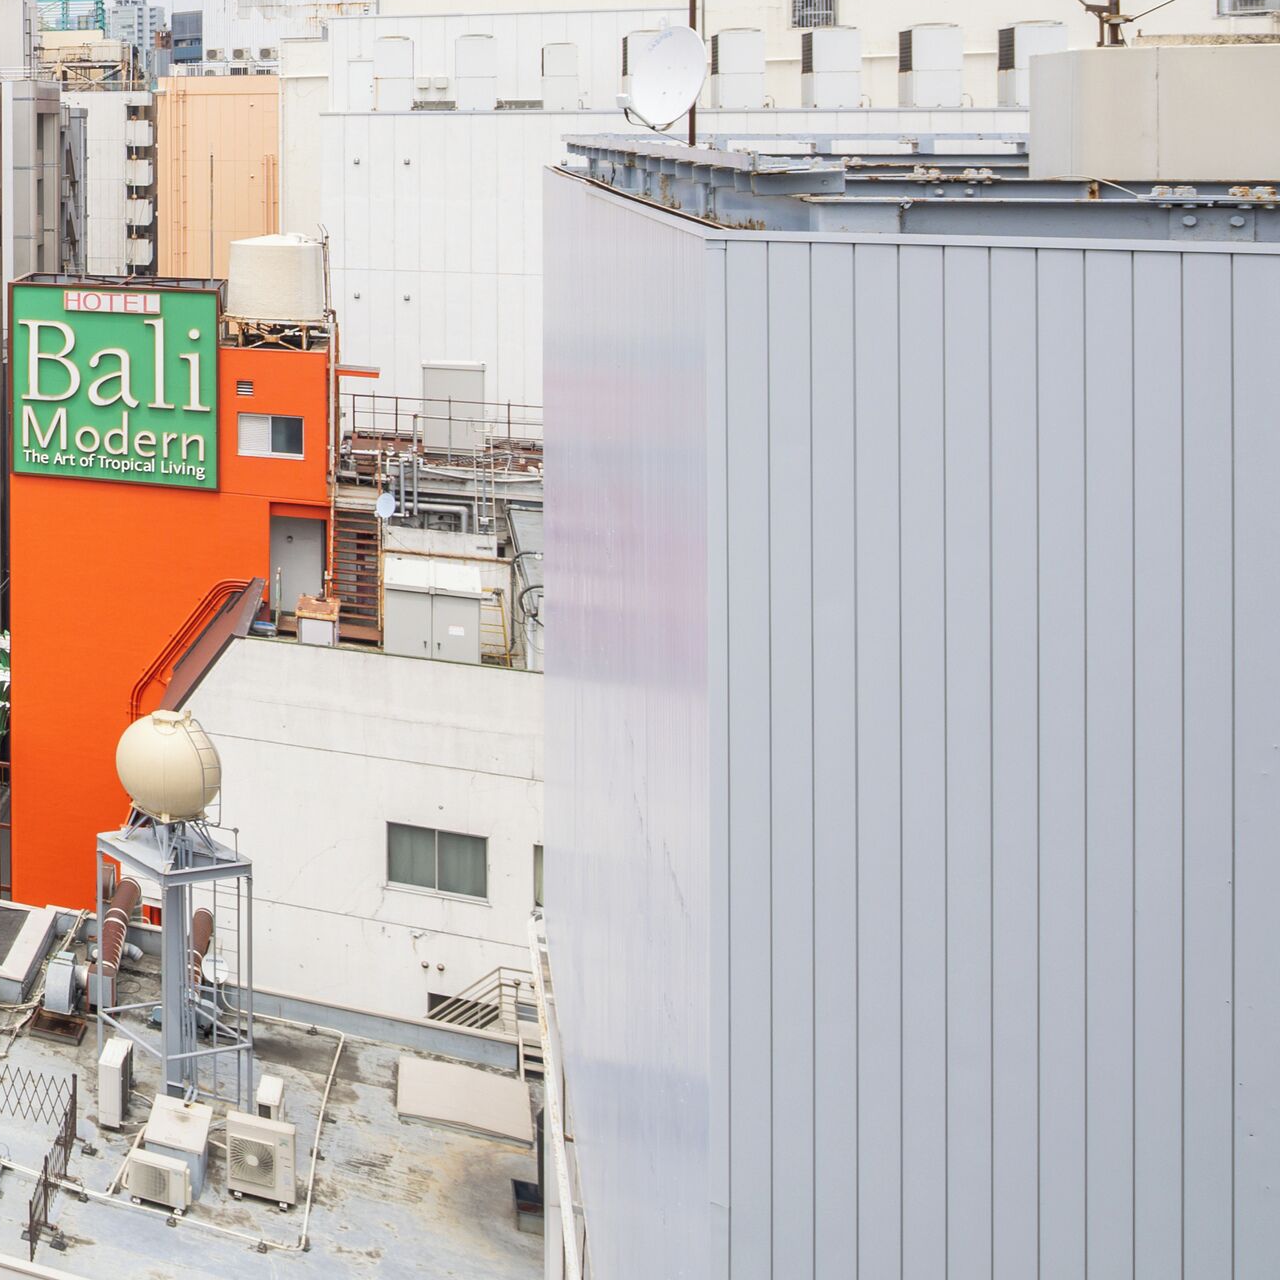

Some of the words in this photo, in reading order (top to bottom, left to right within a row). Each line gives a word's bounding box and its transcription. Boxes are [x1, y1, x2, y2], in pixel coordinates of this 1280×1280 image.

[65, 292, 159, 314] HOTEL
[18, 317, 211, 412] Bali
[22, 405, 206, 462] Modern
[23, 449, 50, 465] The
[53, 453, 76, 466] Art
[79, 454, 96, 468] of
[96, 455, 155, 473] Tropical
[160, 461, 206, 481] Living
